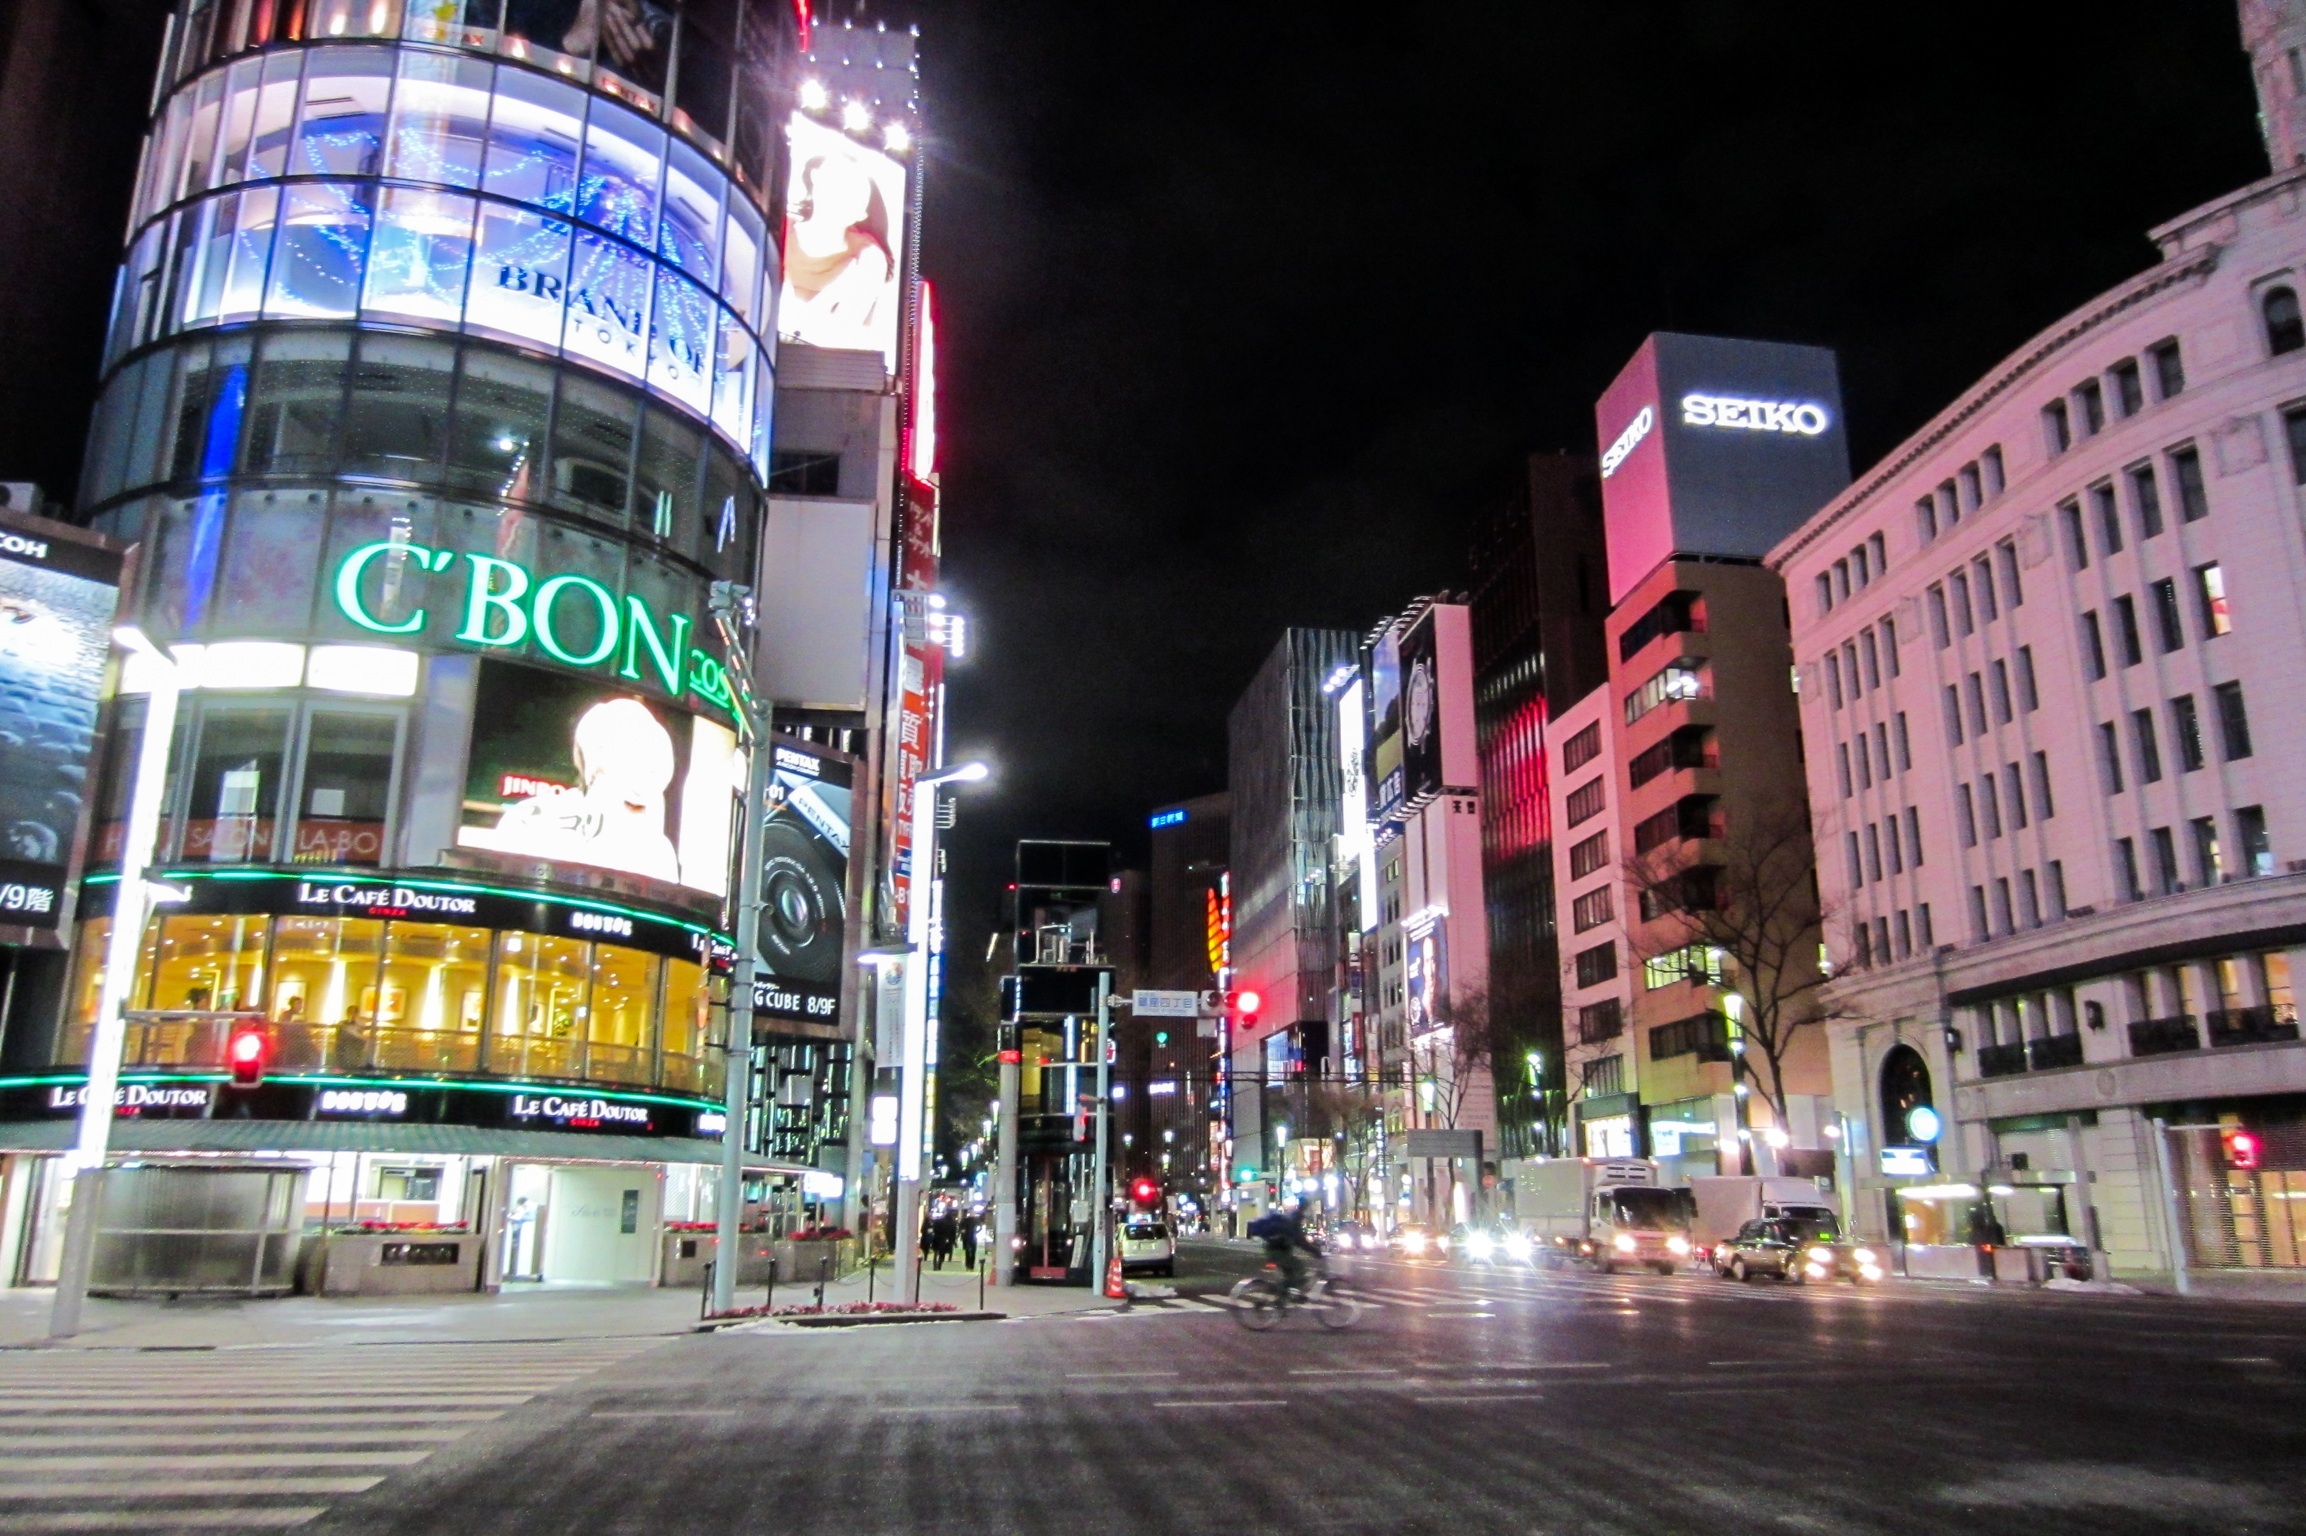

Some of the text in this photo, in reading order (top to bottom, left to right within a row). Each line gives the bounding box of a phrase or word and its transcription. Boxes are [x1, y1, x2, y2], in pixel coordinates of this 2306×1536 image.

[1601, 406, 1653, 479] SEIKO
[1683, 394, 1827, 456] SEIKO
[336, 541, 692, 696] C'BON
[393, 887, 477, 913] DOUTOR
[765, 991, 801, 1011] CUBE
[807, 996, 836, 1015] 8/9F
[126, 1084, 208, 1106] DOUTOR
